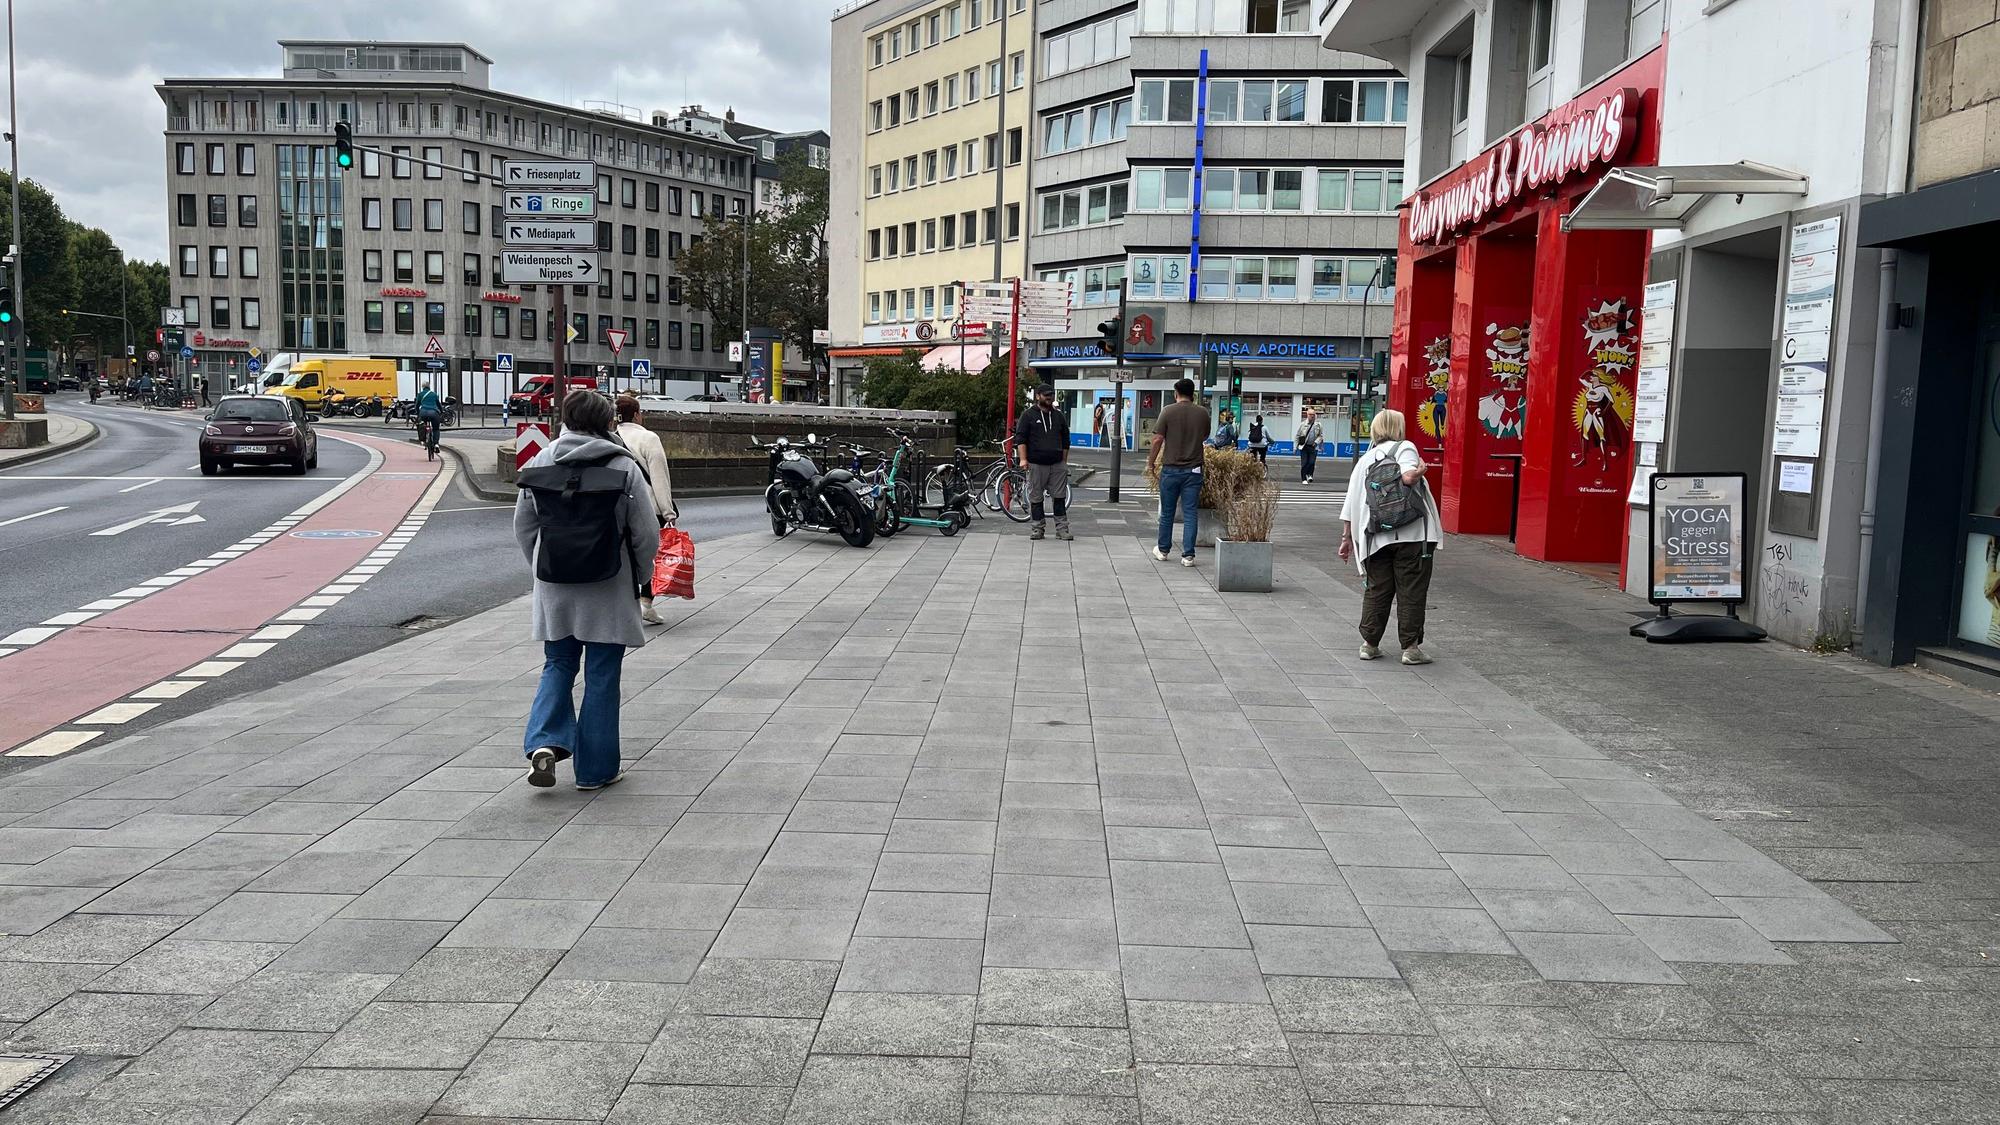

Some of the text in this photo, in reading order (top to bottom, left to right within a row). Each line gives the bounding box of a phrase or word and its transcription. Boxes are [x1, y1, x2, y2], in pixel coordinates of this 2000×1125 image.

[1409, 88, 1625, 246] Currywurst & Pommes
[527, 168, 581, 181] Friesenplatz
[552, 198, 584, 211] Ringe
[527, 228, 576, 240] Mediapark
[508, 254, 573, 267] Weidenpesch
[540, 268, 573, 280] Nippes
[1053, 345, 1080, 358] HANSA
[1257, 343, 1335, 356] APOTHEKE
[1596, 350, 1635, 368] WOW!
[1492, 361, 1527, 377] WOW!
[346, 371, 385, 381] DHL
[1667, 508, 1730, 523] YOGA
[1681, 526, 1716, 538] gegen
[1667, 536, 1729, 555] Stress
